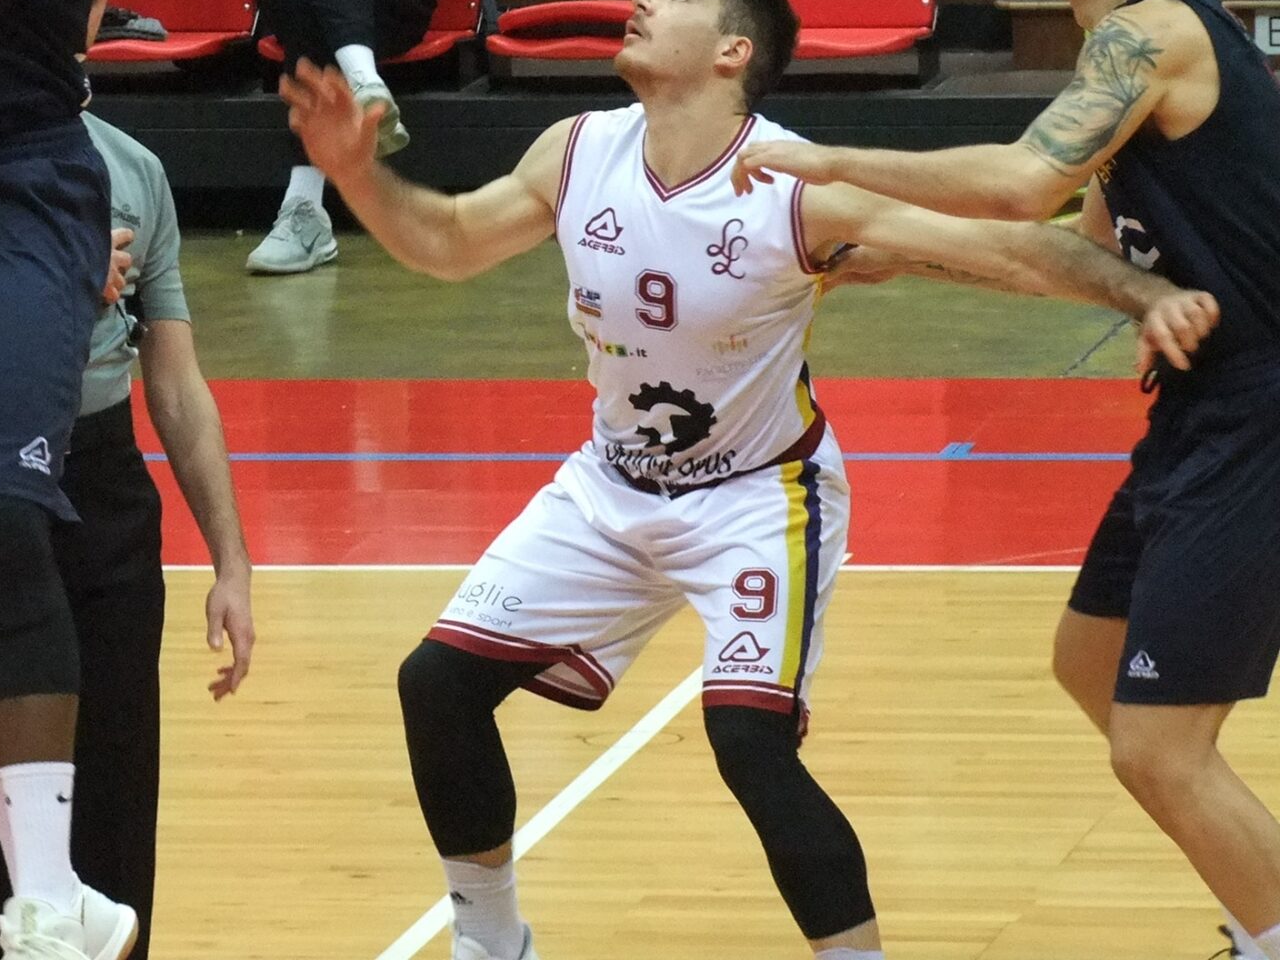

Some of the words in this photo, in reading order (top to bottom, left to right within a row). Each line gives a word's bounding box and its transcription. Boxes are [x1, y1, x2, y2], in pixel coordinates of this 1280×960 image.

[634, 268, 679, 332] 9
[729, 567, 780, 623] 9
[711, 664, 774, 675] ACERBIS
